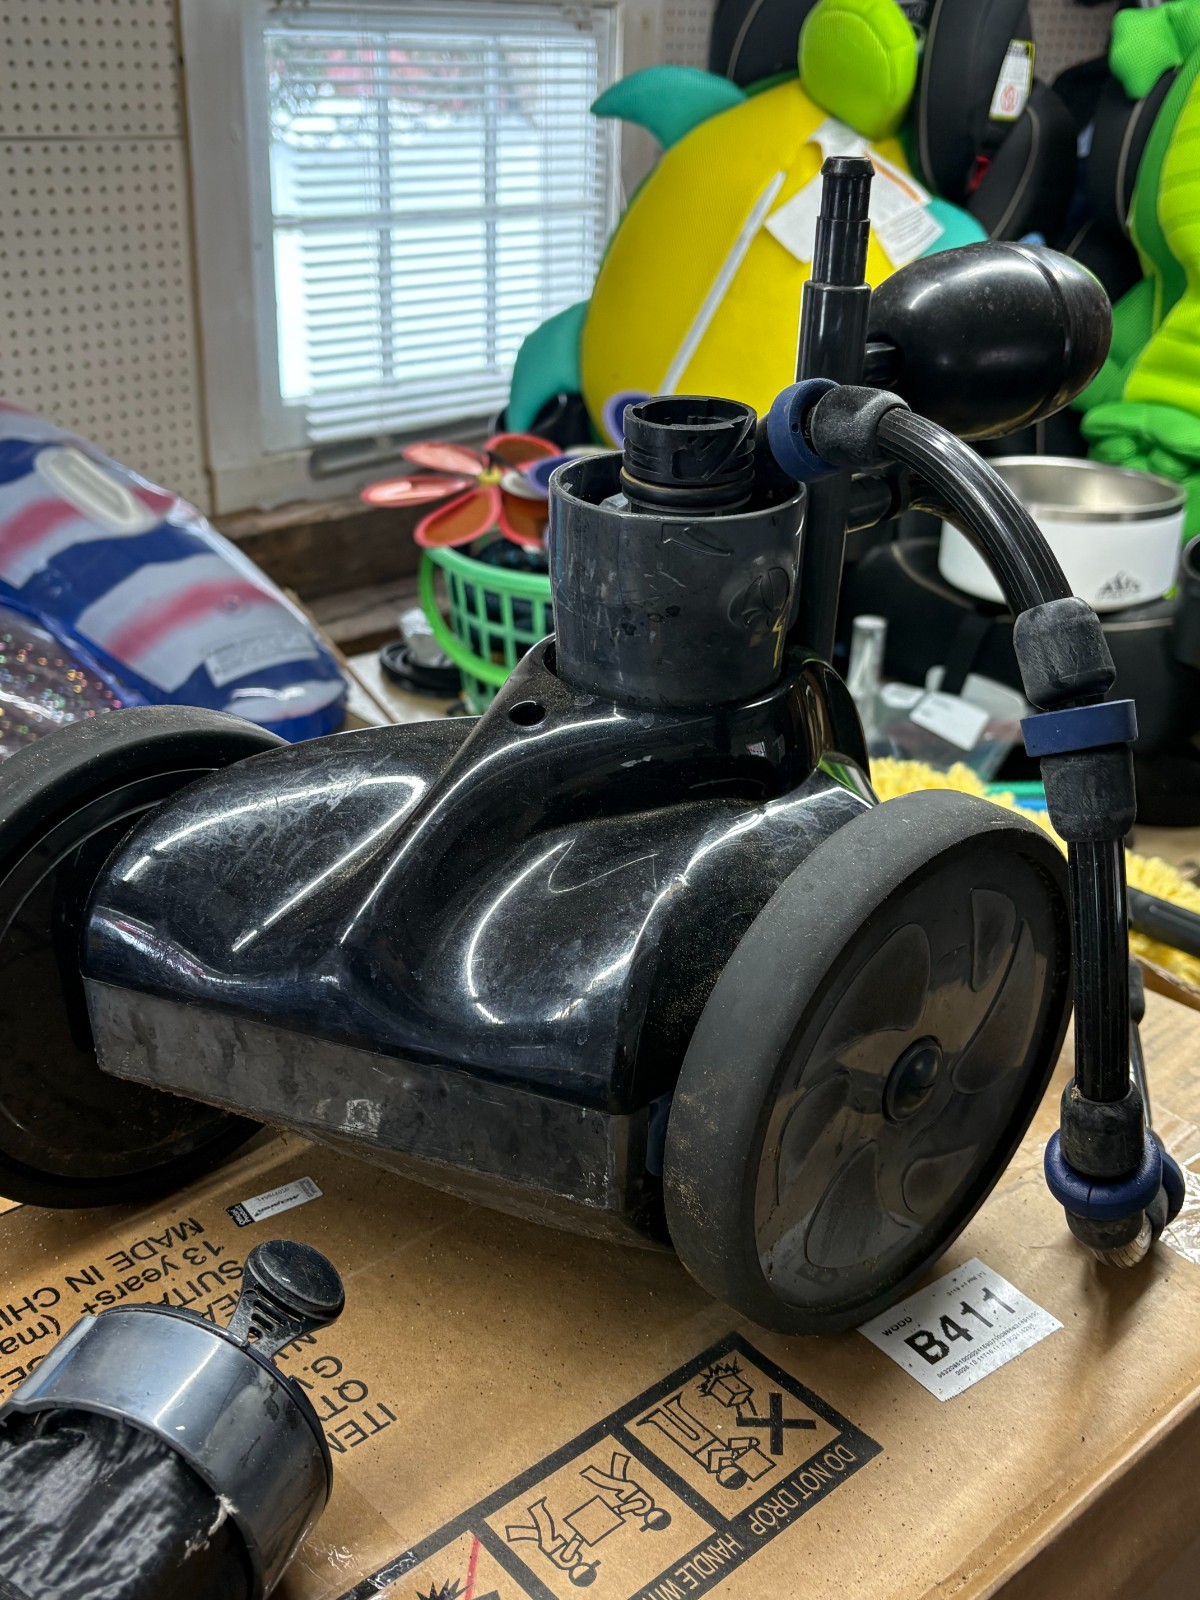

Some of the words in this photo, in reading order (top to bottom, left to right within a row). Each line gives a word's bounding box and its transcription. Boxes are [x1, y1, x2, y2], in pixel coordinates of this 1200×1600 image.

[105, 1218, 204, 1272] MADE
[182, 1240, 224, 1266] 13
[64, 1265, 105, 1293] IN
[80, 1254, 181, 1315] years+
[0, 1287, 60, 1331] CHI
[881, 1316, 913, 1337] WOOD
[904, 1287, 1015, 1365] B411
[823, 1444, 857, 1471] DO
[791, 1462, 834, 1500] NOT
[748, 1489, 799, 1535] DROP
[674, 1533, 744, 1590] HANDLE
